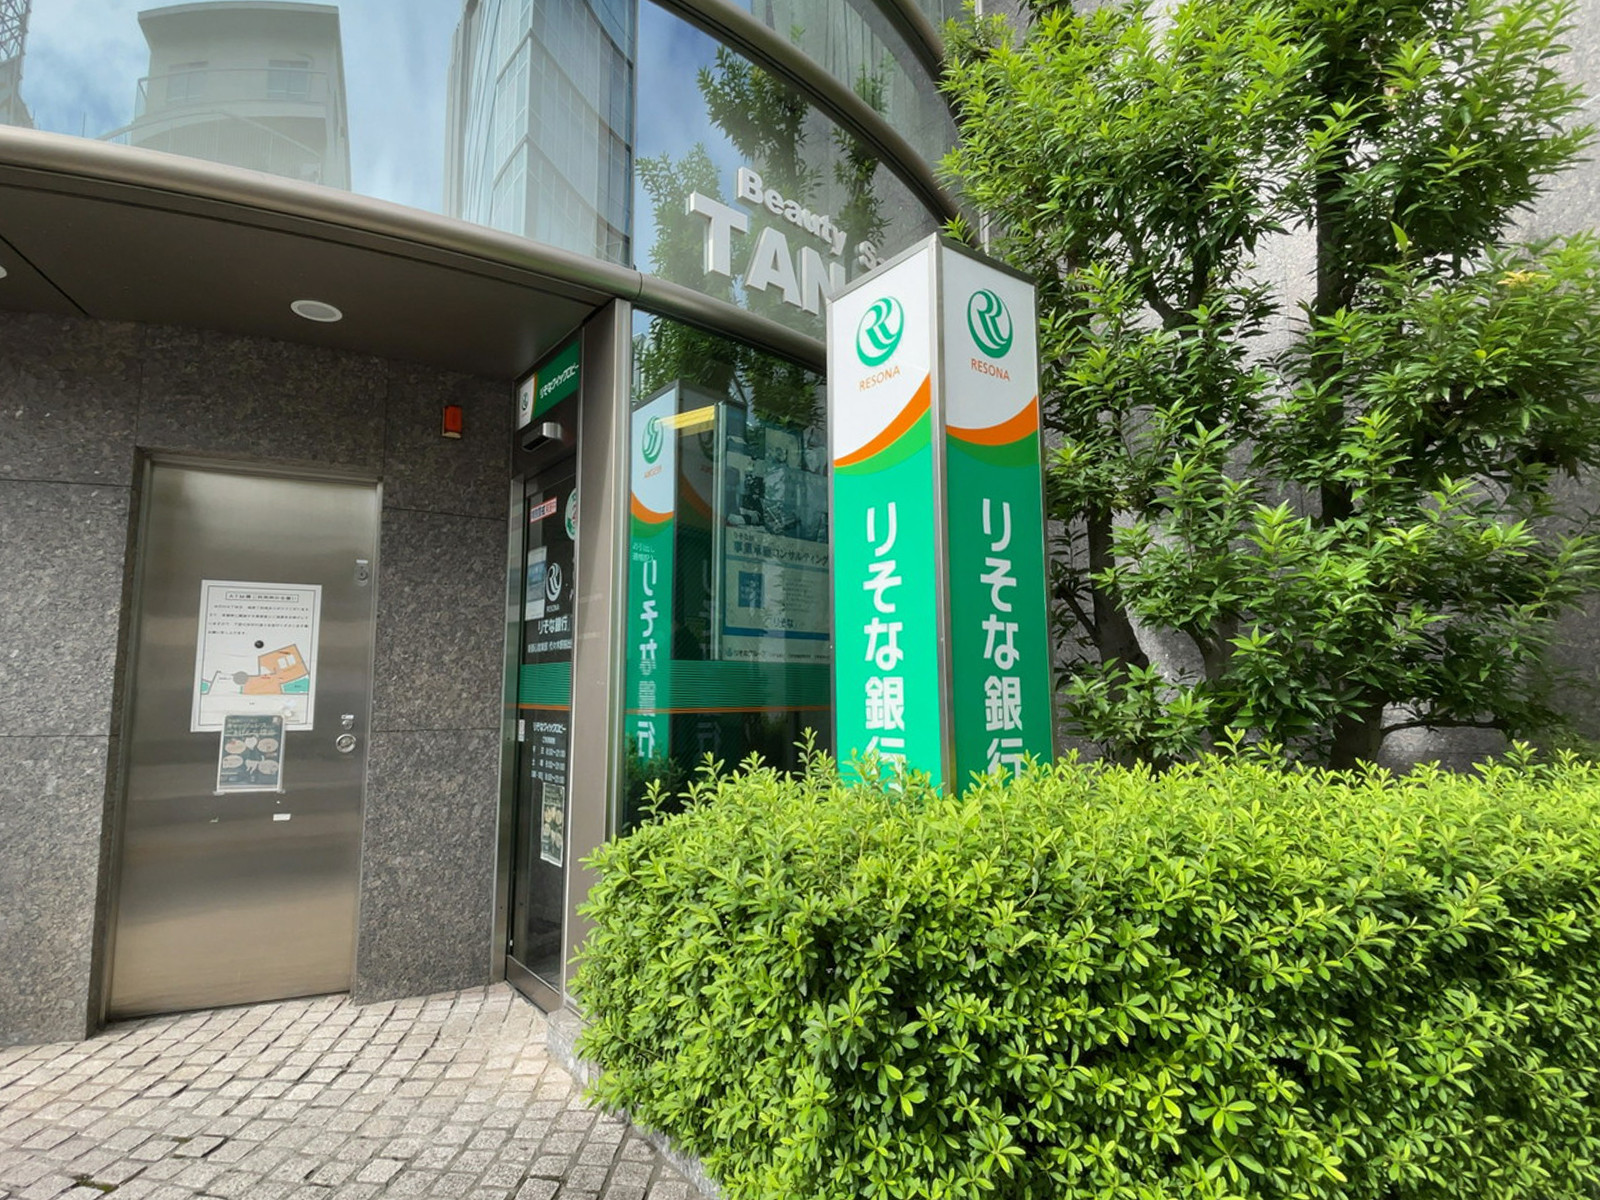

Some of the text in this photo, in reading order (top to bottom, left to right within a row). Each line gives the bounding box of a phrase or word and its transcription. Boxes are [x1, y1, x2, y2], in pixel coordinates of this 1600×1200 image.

[737, 166, 886, 271] Beauty S
[859, 365, 901, 392] RESONA
[971, 358, 1010, 382] RESONA
[980, 498, 1024, 778] りそな銀行
